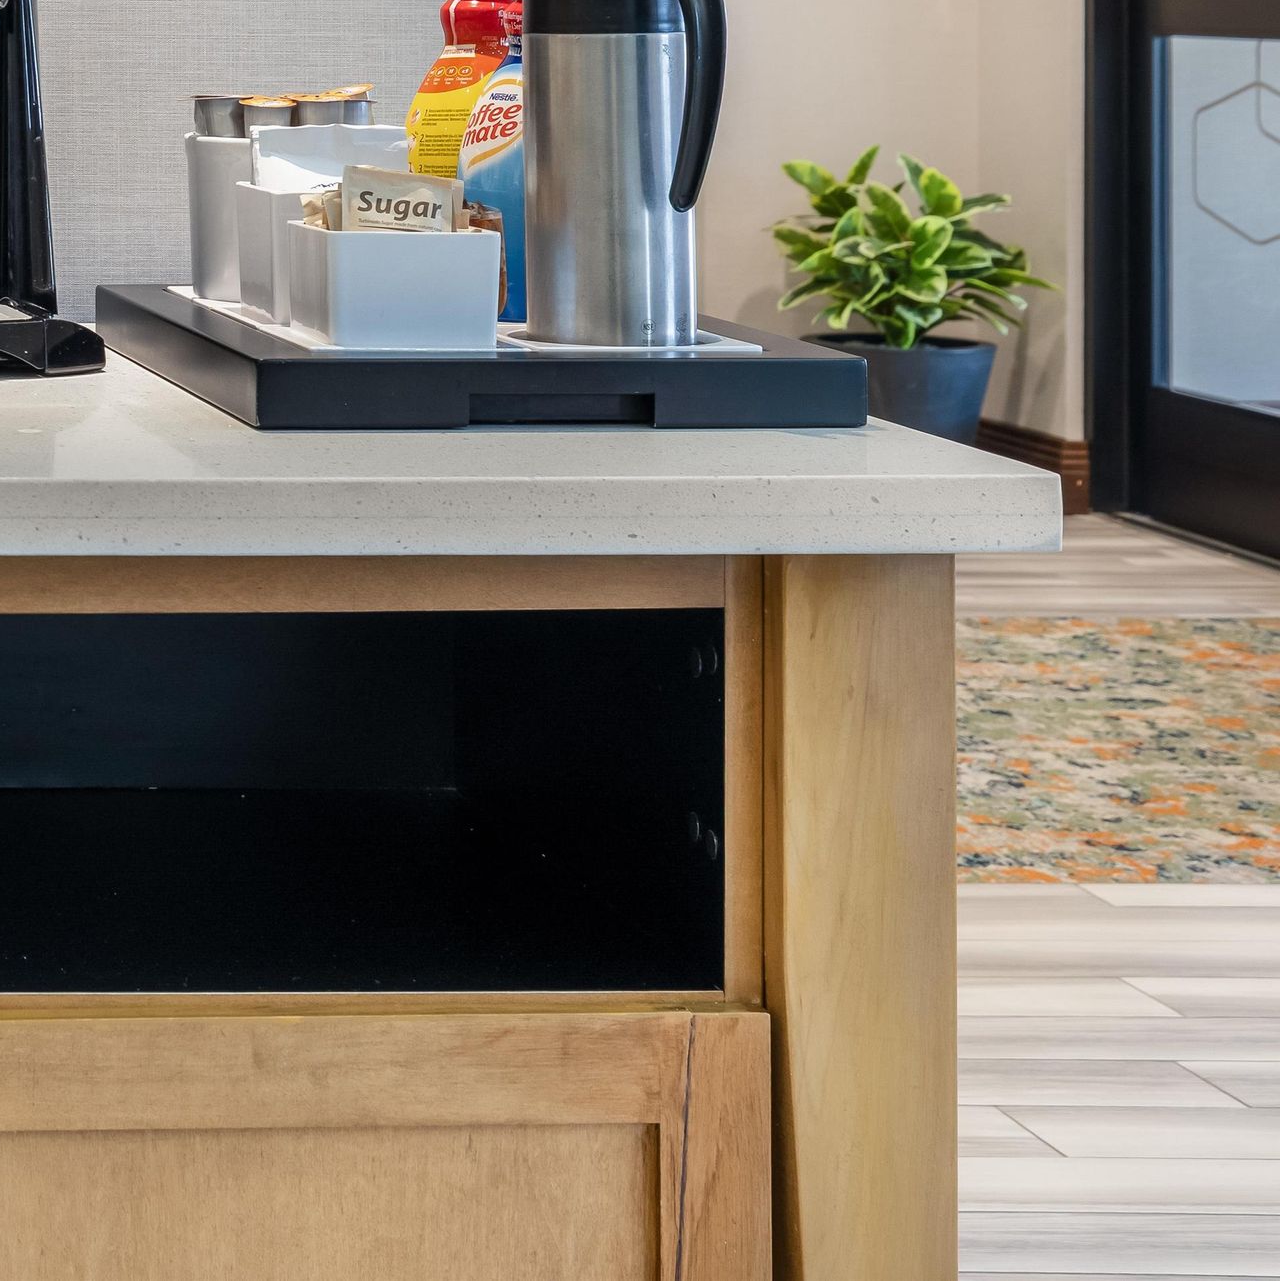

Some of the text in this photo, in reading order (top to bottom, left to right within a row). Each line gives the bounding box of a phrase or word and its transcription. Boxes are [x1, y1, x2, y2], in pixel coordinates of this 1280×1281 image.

[468, 103, 523, 129] offee
[463, 120, 519, 148] mate
[357, 190, 442, 221] Sugar
